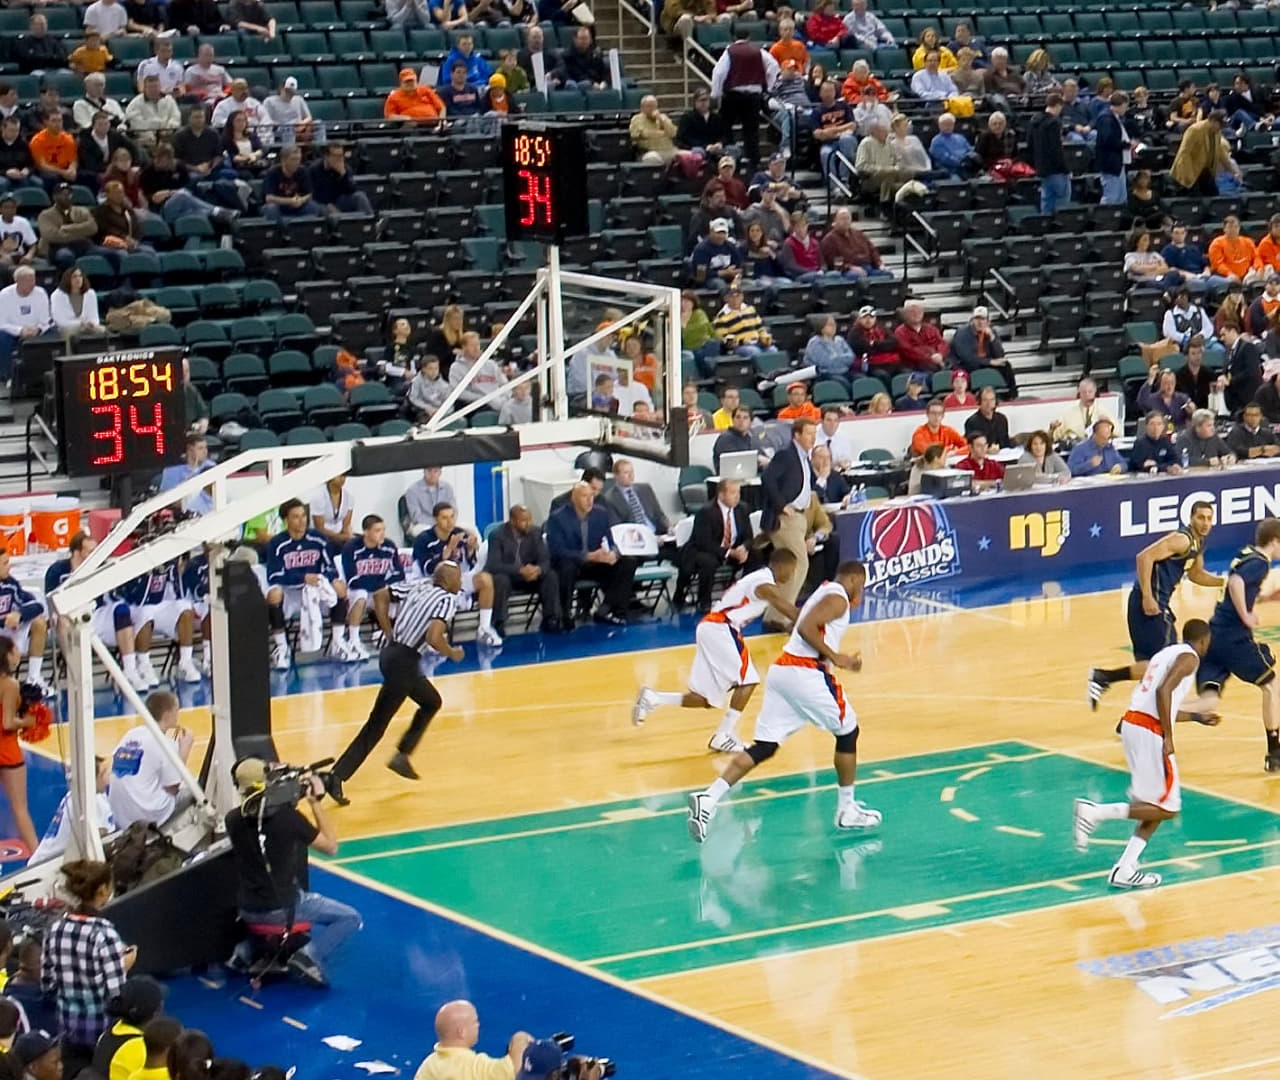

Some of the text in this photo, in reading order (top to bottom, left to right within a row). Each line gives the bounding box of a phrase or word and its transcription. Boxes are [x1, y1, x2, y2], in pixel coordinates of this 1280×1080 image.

[518, 169, 552, 225] 34
[89, 362, 172, 400] 18:54
[91, 402, 165, 464] 34
[53, 518, 69, 533] G
[863, 538, 955, 588] LEGENDS
[873, 565, 951, 598] CLASSIC
